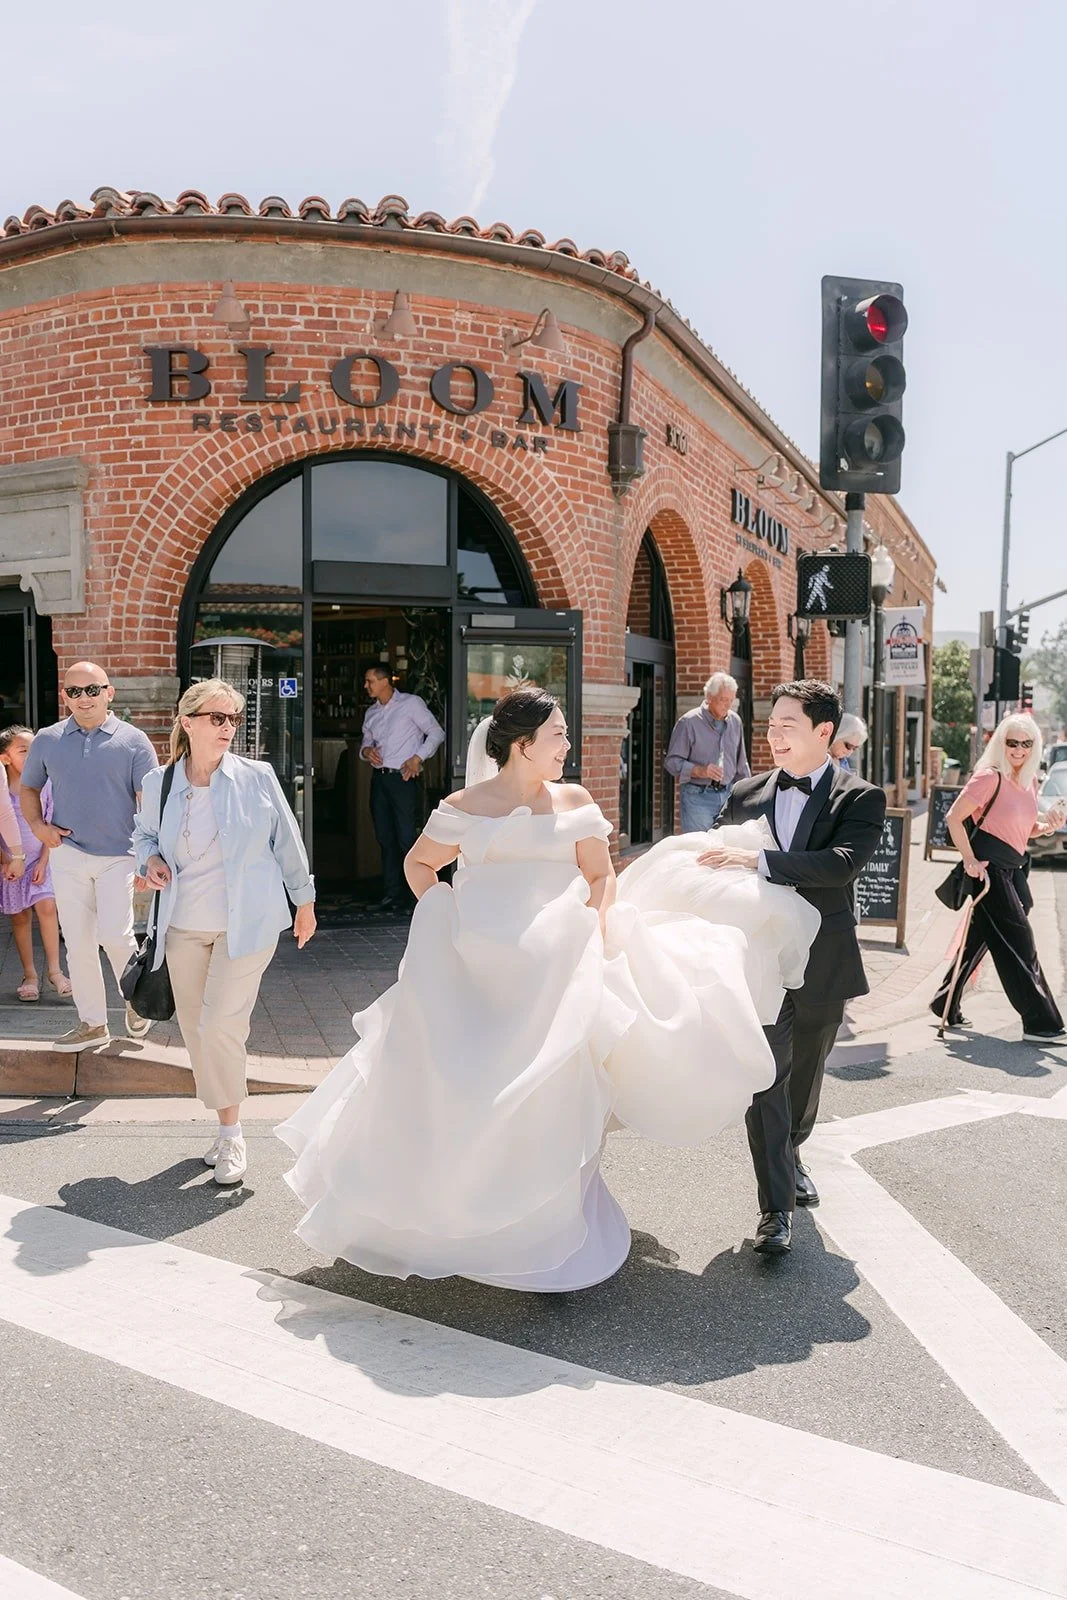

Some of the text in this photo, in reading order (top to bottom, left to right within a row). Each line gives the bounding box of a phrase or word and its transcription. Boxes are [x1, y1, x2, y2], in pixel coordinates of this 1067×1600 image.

[143, 347, 583, 432] BLOOM
[192, 413, 440, 441] RESTAURANT
[491, 430, 548, 454] BAR
[869, 862, 889, 872] DAILY
